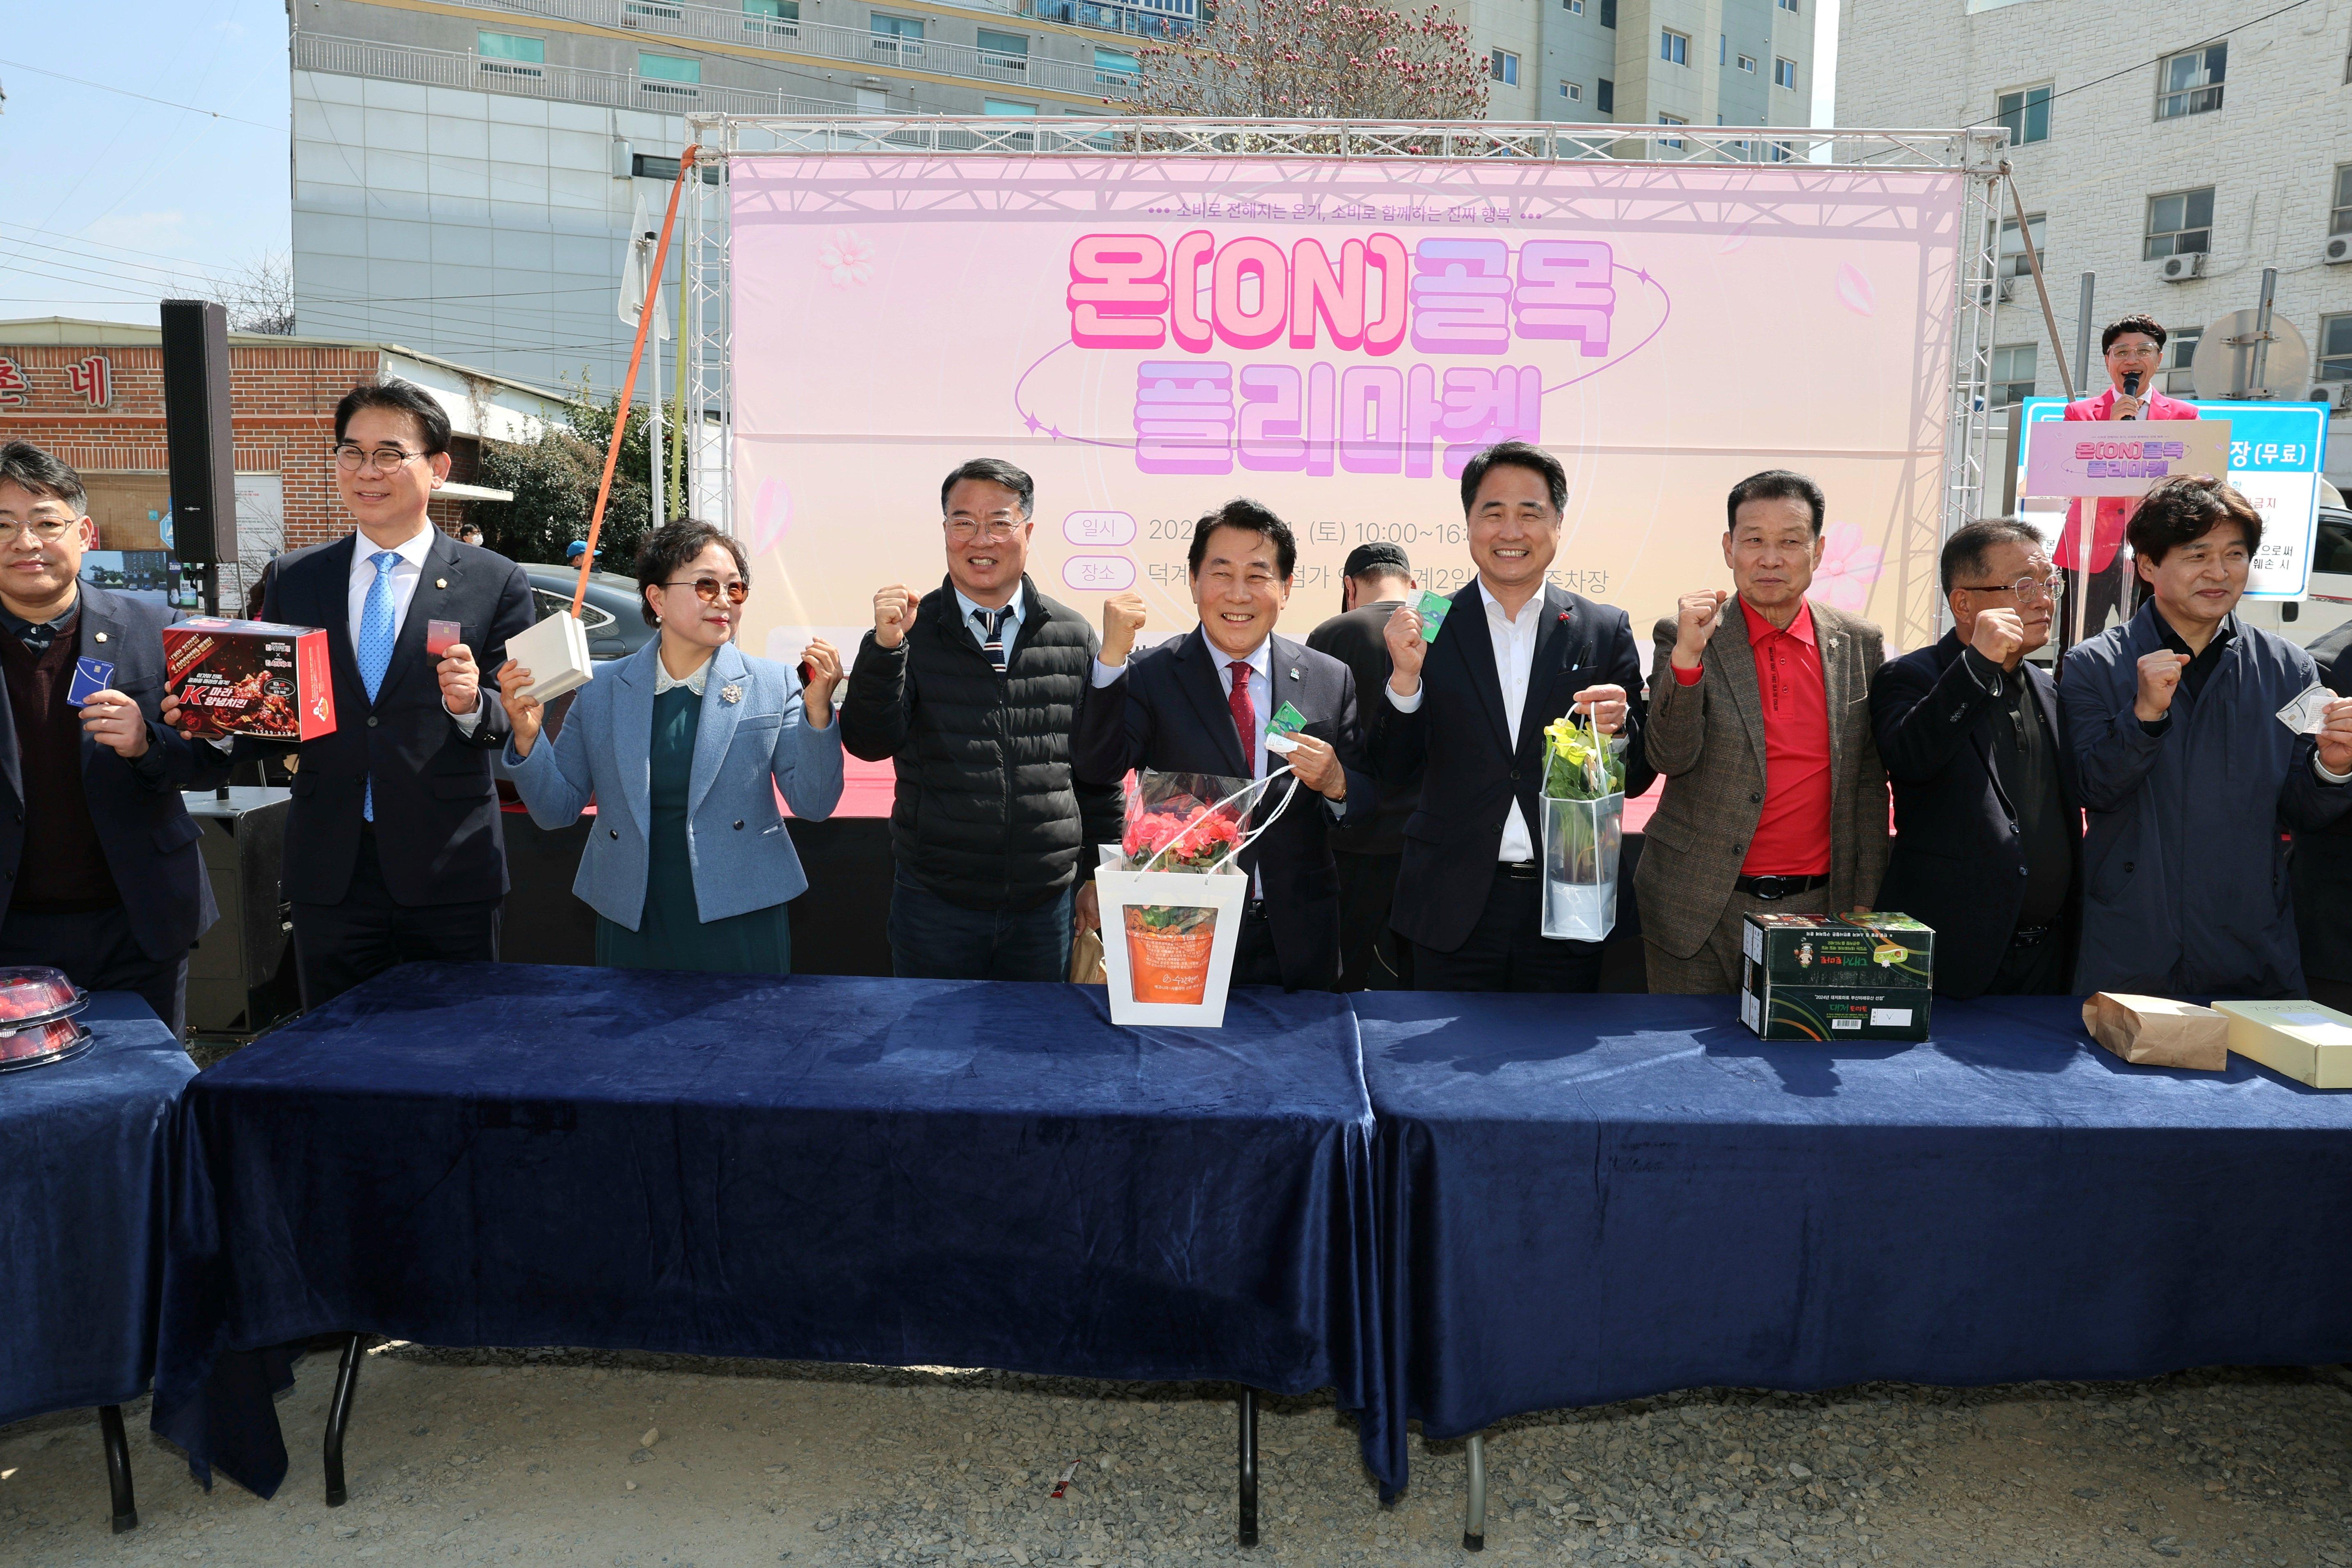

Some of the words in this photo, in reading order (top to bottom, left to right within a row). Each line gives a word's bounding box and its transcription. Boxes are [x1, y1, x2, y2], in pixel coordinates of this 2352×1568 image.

[1177, 203, 1222, 218] 소비로
[1227, 203, 1287, 219] 전해지는
[1291, 203, 1326, 222] 온기,
[1331, 204, 1376, 221] 소비로
[1381, 205, 1441, 222] 함께하는
[1447, 206, 1477, 223] 진짜
[1481, 206, 1511, 224] 행복
[1066, 229, 1616, 358] 온(ON)골목
[1134, 361, 1543, 480] 플리마켓
[2075, 441, 2184, 460] 온(ON)골목
[2087, 460, 2169, 478] 플리마켓
[1082, 519, 1115, 538] 일시
[1149, 519, 1193, 539] 202
[1309, 521, 1346, 546] (토)
[1355, 521, 1469, 544] 10:00~16:
[1081, 563, 1115, 582] 장소
[2280, 560, 2290, 570] 시
[1415, 567, 1473, 590] 계2임
[209, 687, 233, 697] 마라
[204, 696, 248, 709] 양념치킨
[1843, 955, 1867, 966] 대저
[1829, 1004, 1849, 1012] 대저
